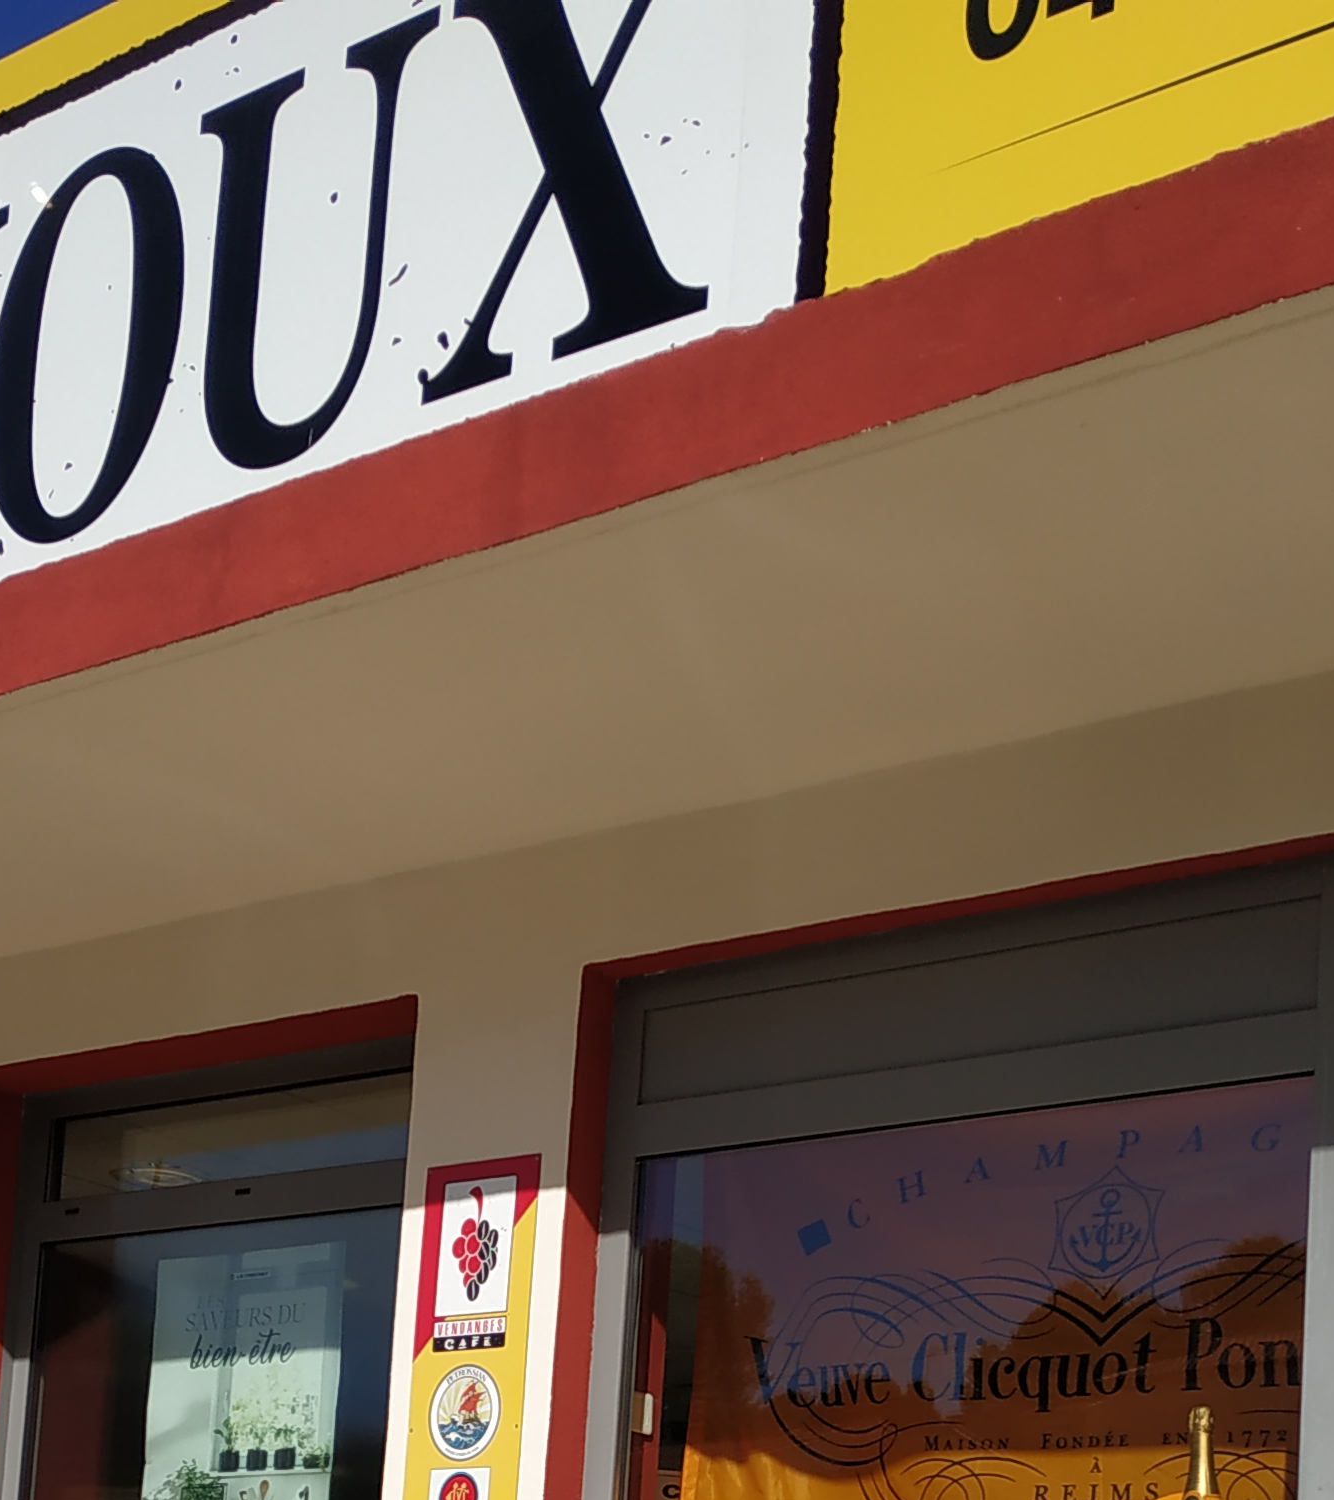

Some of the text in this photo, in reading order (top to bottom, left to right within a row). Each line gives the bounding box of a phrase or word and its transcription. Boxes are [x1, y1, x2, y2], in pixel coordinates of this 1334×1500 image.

[437, 1318, 503, 1336] VENDANGES
[189, 1328, 297, 1370] bien-être
[744, 1335, 892, 1411] Veuve
[910, 1329, 1157, 1414] Clicquot
[1227, 1429, 1289, 1449] 1772
[1089, 1457, 1102, 1474] À
